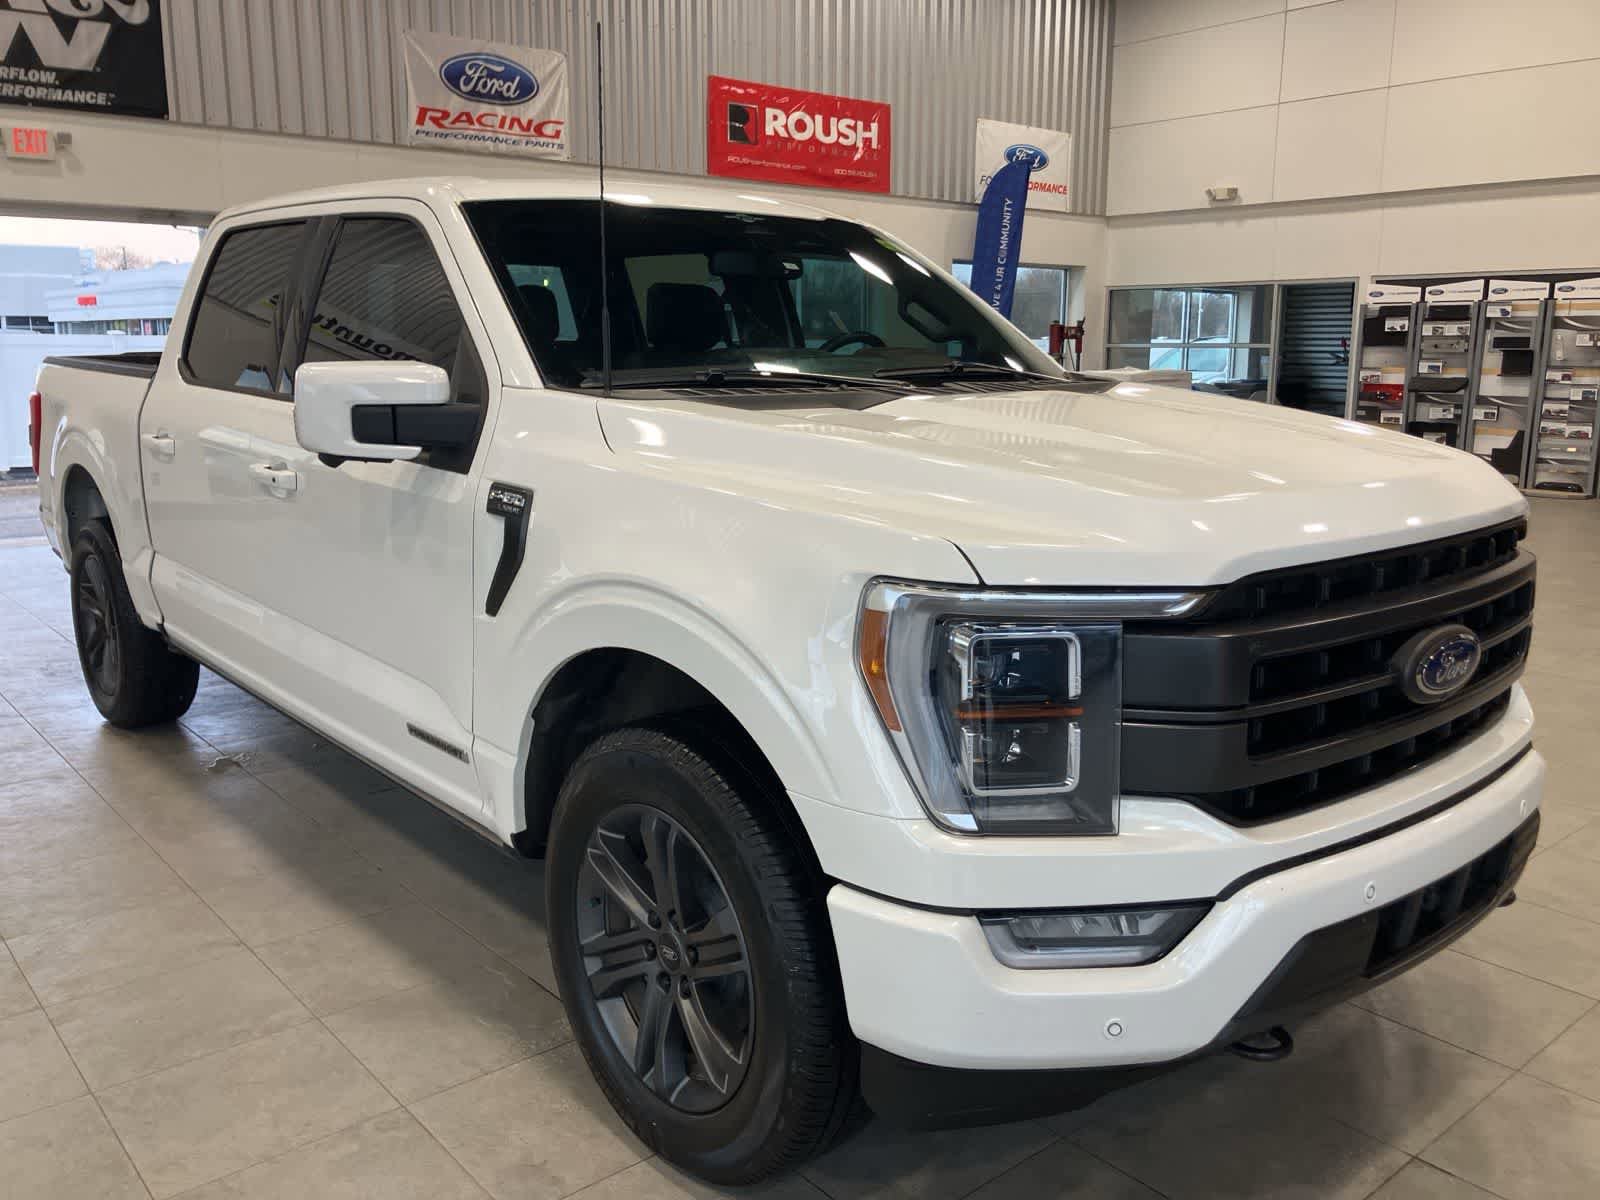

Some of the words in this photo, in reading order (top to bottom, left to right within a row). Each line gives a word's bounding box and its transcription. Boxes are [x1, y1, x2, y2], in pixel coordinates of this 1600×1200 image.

[459, 60, 520, 98] Ford
[415, 105, 565, 139] RACING
[765, 107, 879, 149] ROUSH
[13, 128, 48, 155] EXIT
[415, 129, 520, 146] PERFORMANCE
[525, 139, 564, 150] PARTS
[1028, 181, 1068, 195] ORMANCE
[997, 198, 1013, 265] COMMUNITY
[995, 266, 1005, 282] UR
